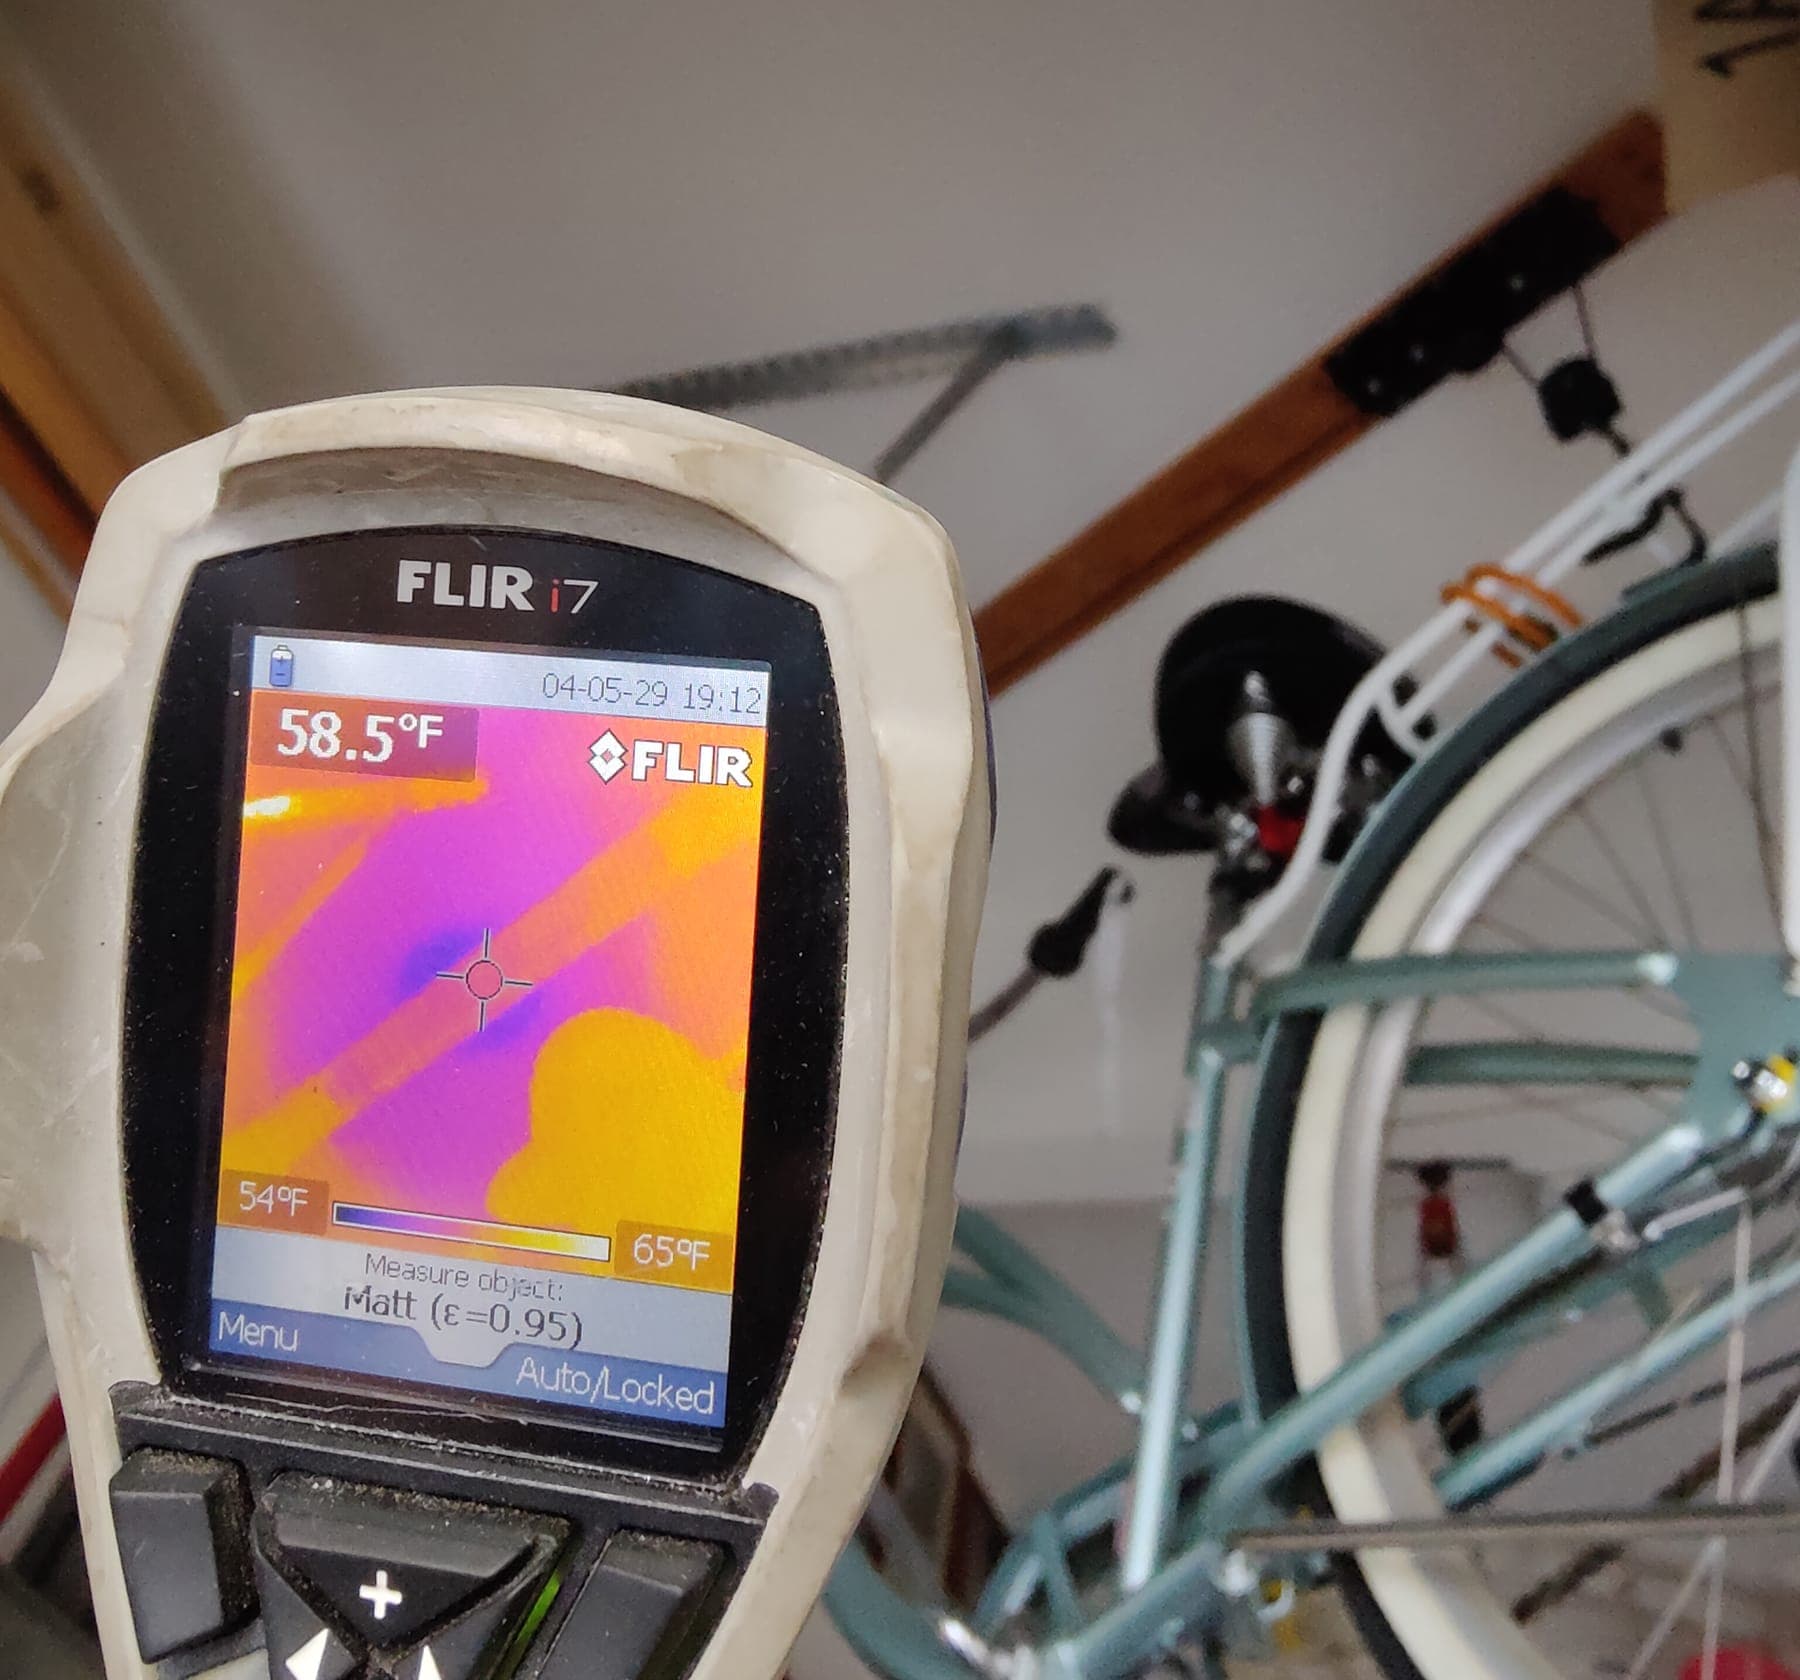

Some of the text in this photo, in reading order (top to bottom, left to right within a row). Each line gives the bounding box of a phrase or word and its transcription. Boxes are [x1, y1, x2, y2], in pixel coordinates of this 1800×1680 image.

[396, 559, 600, 615] FLIR i7
[542, 672, 762, 716] 04-05-29 19:12
[276, 707, 445, 764] 58.5°F
[630, 740, 754, 788] FLIR
[238, 1180, 310, 1217] 54°F
[632, 1232, 711, 1271] 65°F
[364, 1252, 565, 1303] Measure object:
[343, 1285, 418, 1322] Matt
[217, 1310, 299, 1354] Menu
[515, 1355, 717, 1416] Auto/Locked
